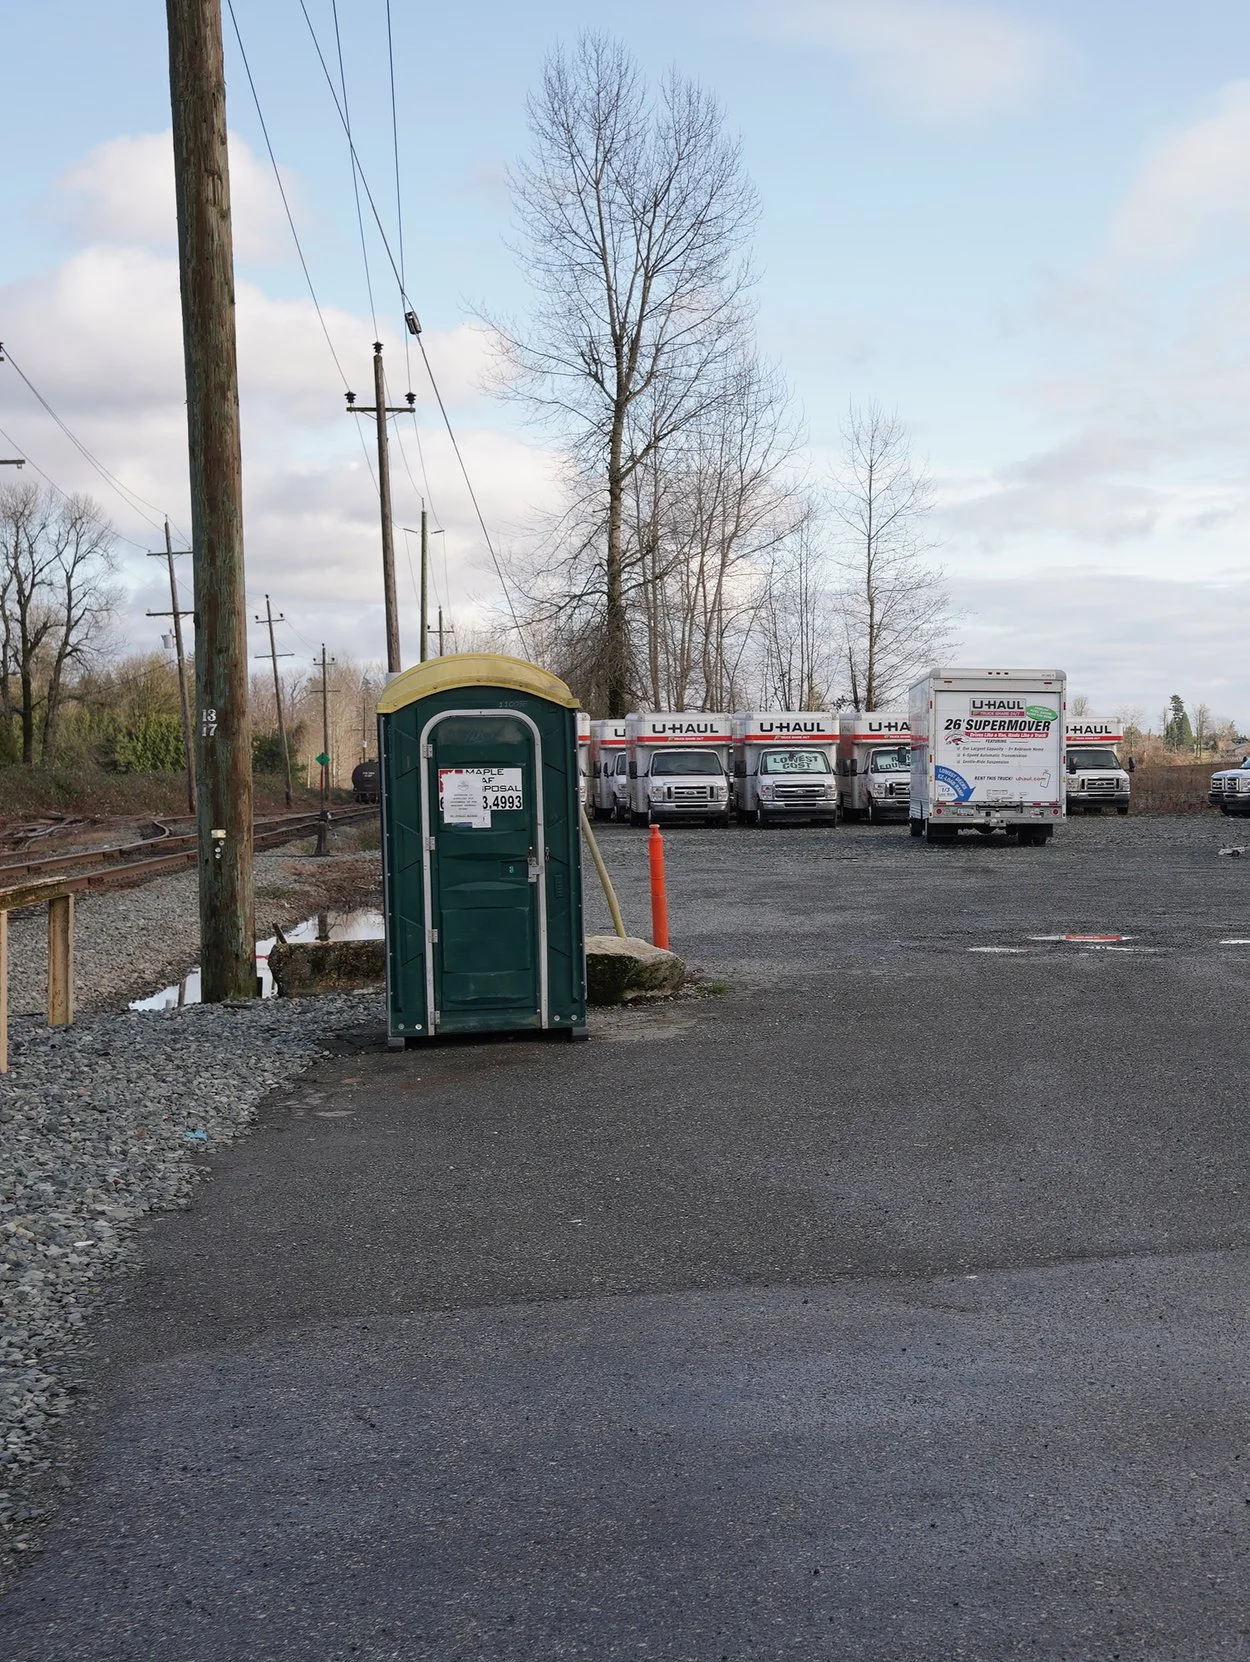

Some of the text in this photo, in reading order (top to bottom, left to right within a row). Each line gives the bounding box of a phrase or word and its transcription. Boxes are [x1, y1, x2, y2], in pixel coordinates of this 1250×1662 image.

[972, 700, 1024, 710] U-HAUL
[202, 708, 216, 722] 13
[202, 724, 218, 736] 17
[652, 724, 719, 734] U-HAUL
[760, 722, 825, 732] U-HAUL
[868, 722, 910, 731] U-HA
[966, 720, 1051, 731] SUPERMOVER
[774, 755, 818, 763] LOWEST
